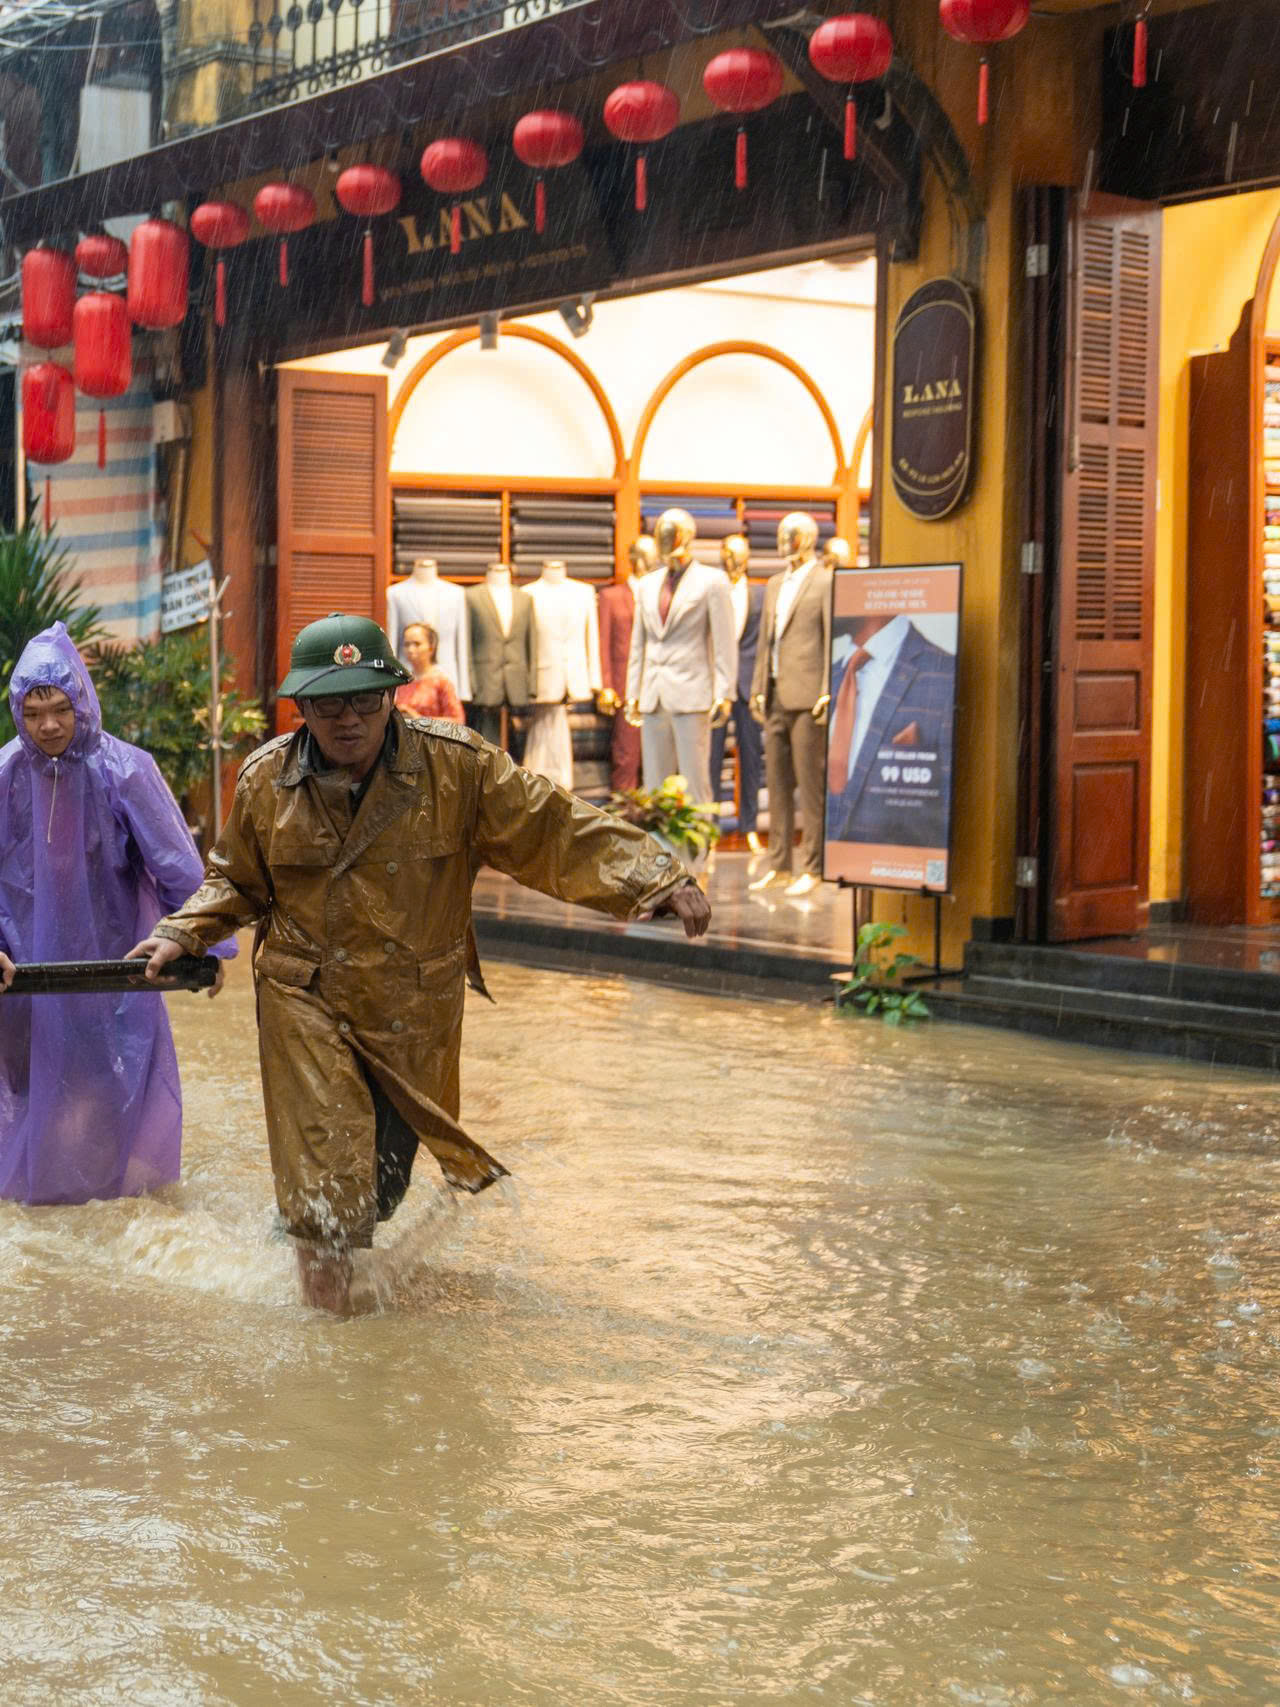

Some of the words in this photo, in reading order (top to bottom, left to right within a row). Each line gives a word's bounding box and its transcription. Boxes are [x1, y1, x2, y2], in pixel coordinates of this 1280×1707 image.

[397, 192, 529, 255] LANA
[903, 379, 961, 404] LANA
[881, 765, 900, 783] 99
[902, 766, 932, 784] USD
